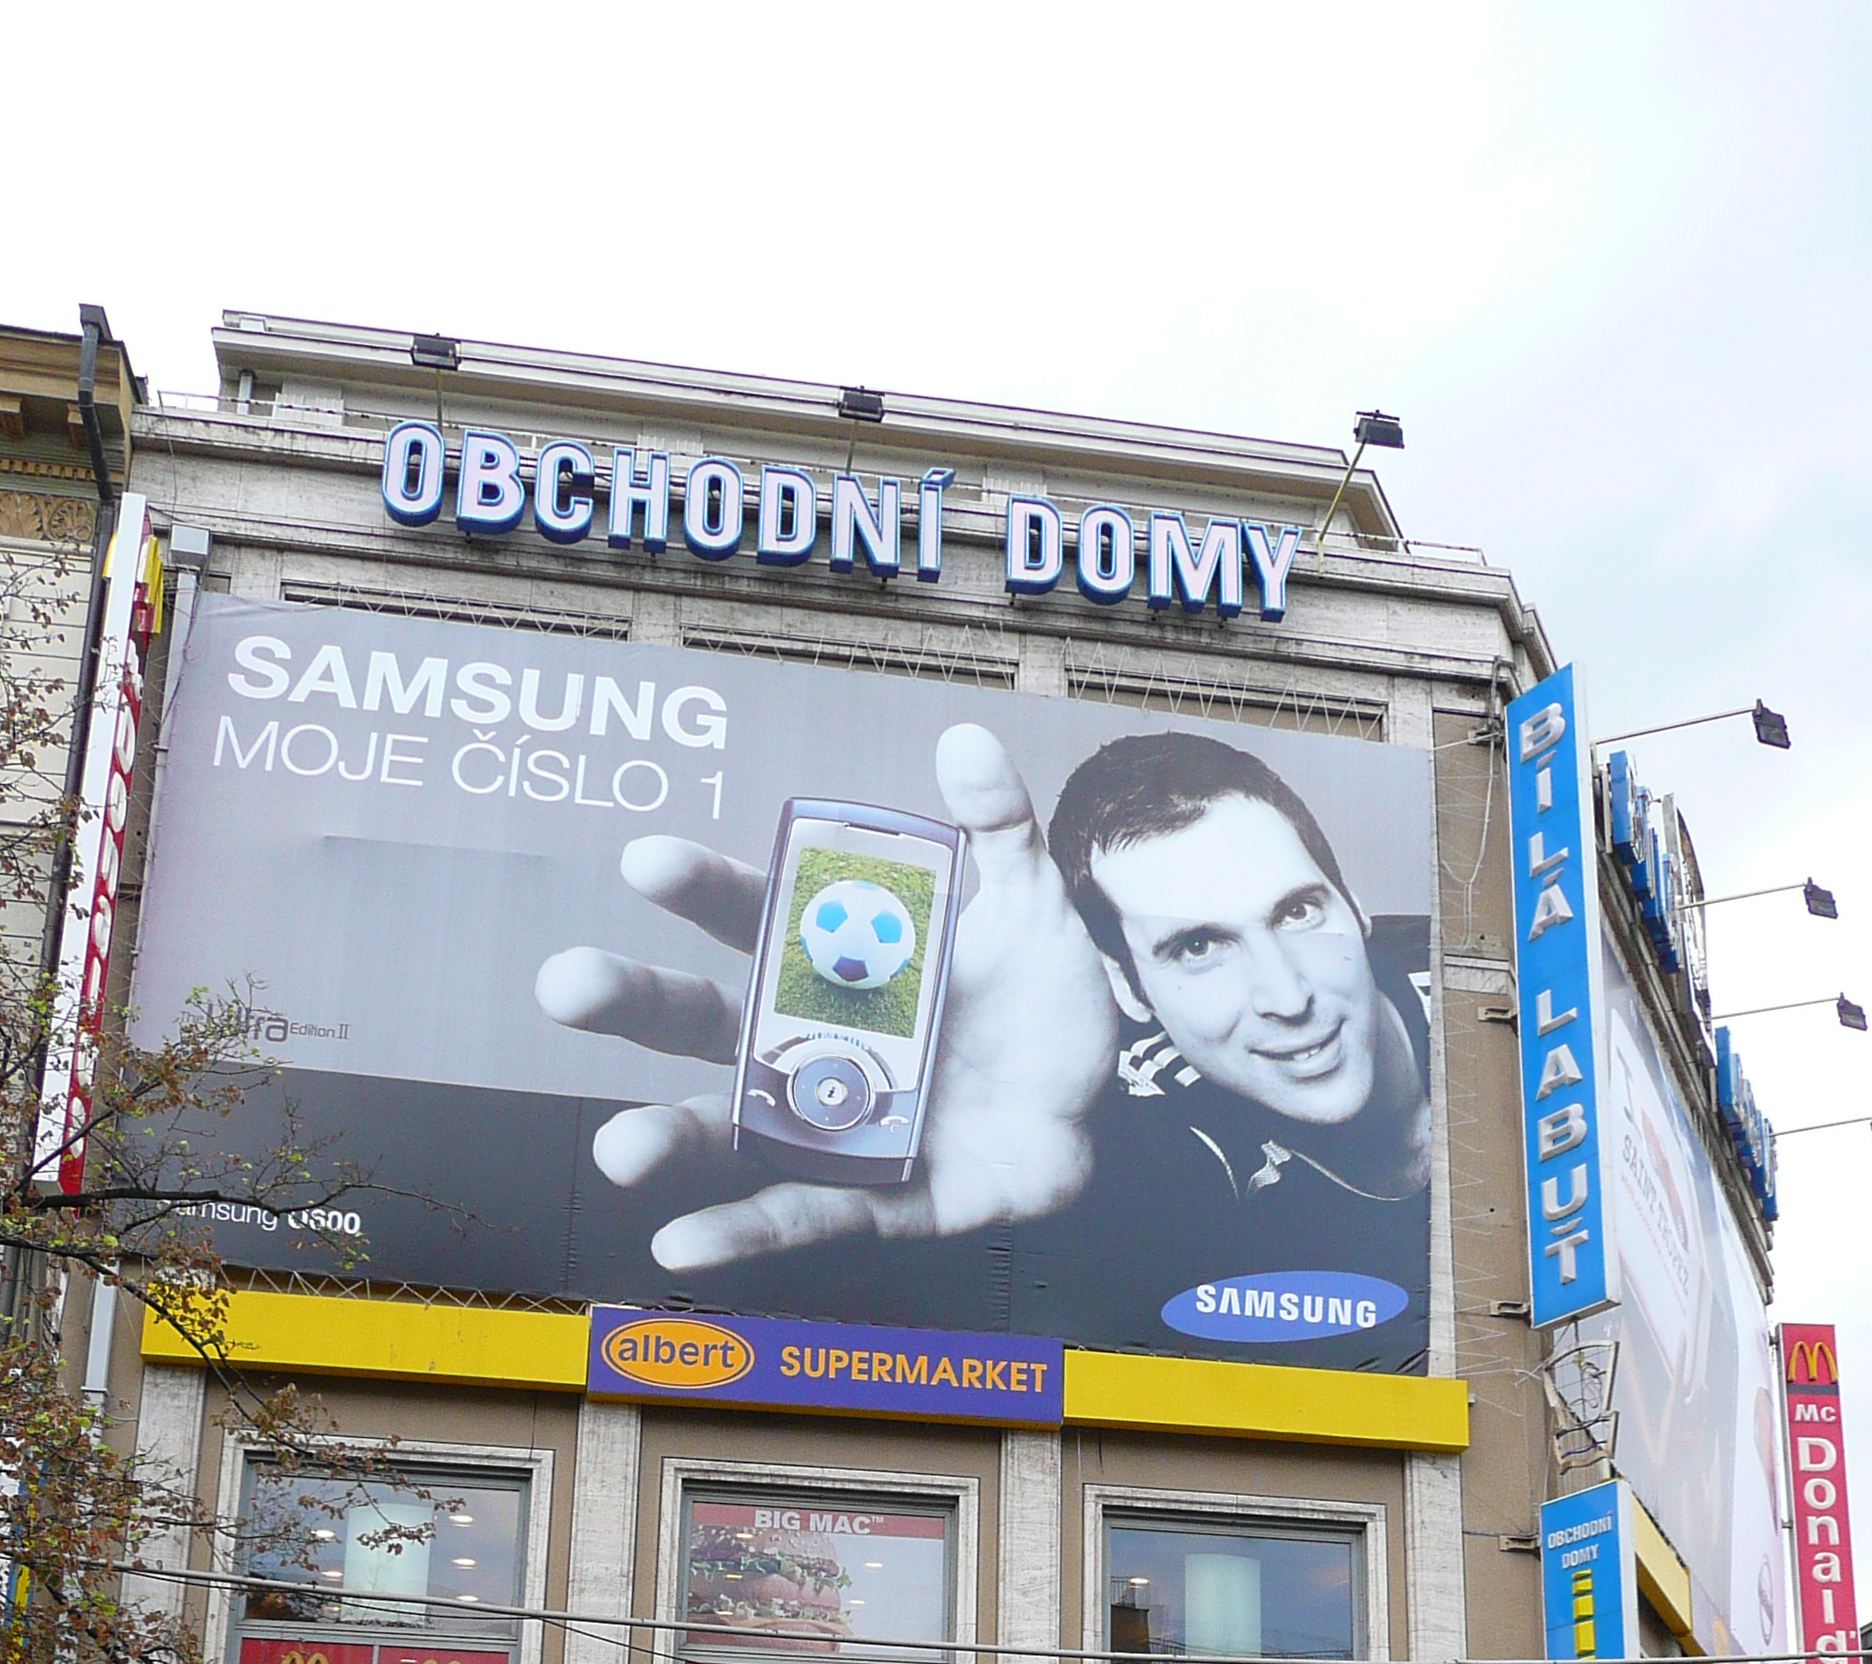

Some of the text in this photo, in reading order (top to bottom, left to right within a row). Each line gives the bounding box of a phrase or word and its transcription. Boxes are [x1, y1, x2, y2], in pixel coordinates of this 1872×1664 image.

[380, 420, 1302, 622] OBCHODNÍ DOMY
[228, 635, 729, 750] SAMSUNG
[212, 715, 724, 820] MOJE ČÍSLO 1
[1518, 701, 1590, 1285] BÍLÁ LABUŤ
[290, 1022, 335, 1038] Edition
[338, 1022, 350, 1040] II
[158, 1199, 279, 1232] amsung
[1195, 1283, 1377, 1329] SAMSUNG
[616, 1331, 1048, 1394] albert SUPERMARKET
[754, 1509, 801, 1531] BIG
[1548, 1510, 1613, 1549] OBCHODNÍ
[1562, 1543, 1599, 1569] DOMY
